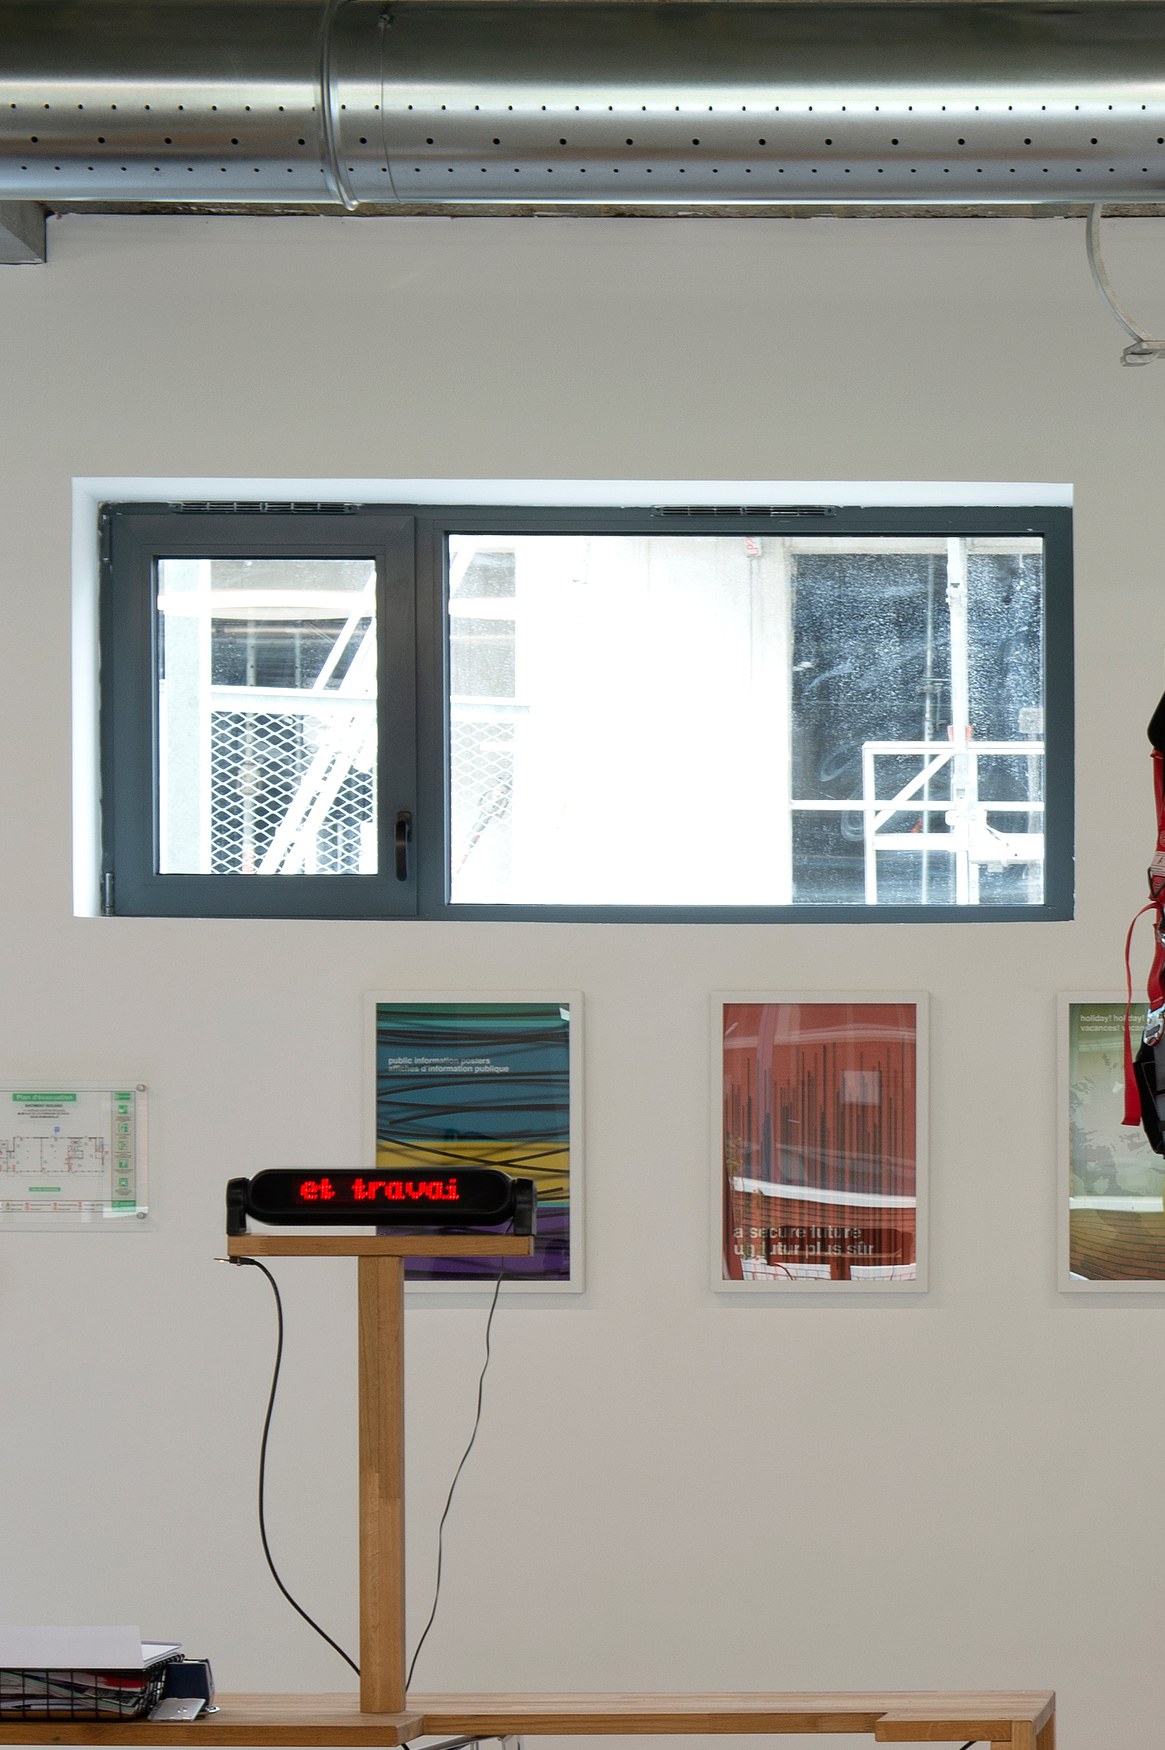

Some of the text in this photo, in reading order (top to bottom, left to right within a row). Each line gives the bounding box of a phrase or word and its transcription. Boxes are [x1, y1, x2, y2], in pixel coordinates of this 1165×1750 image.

[1080, 1014, 1145, 1023] holiday! holday!
[388, 1057, 412, 1065] public
[461, 1057, 490, 1066] posters
[474, 1065, 510, 1074] publique
[300, 1178, 459, 1200] et travai
[733, 1225, 862, 1239] a secure future
